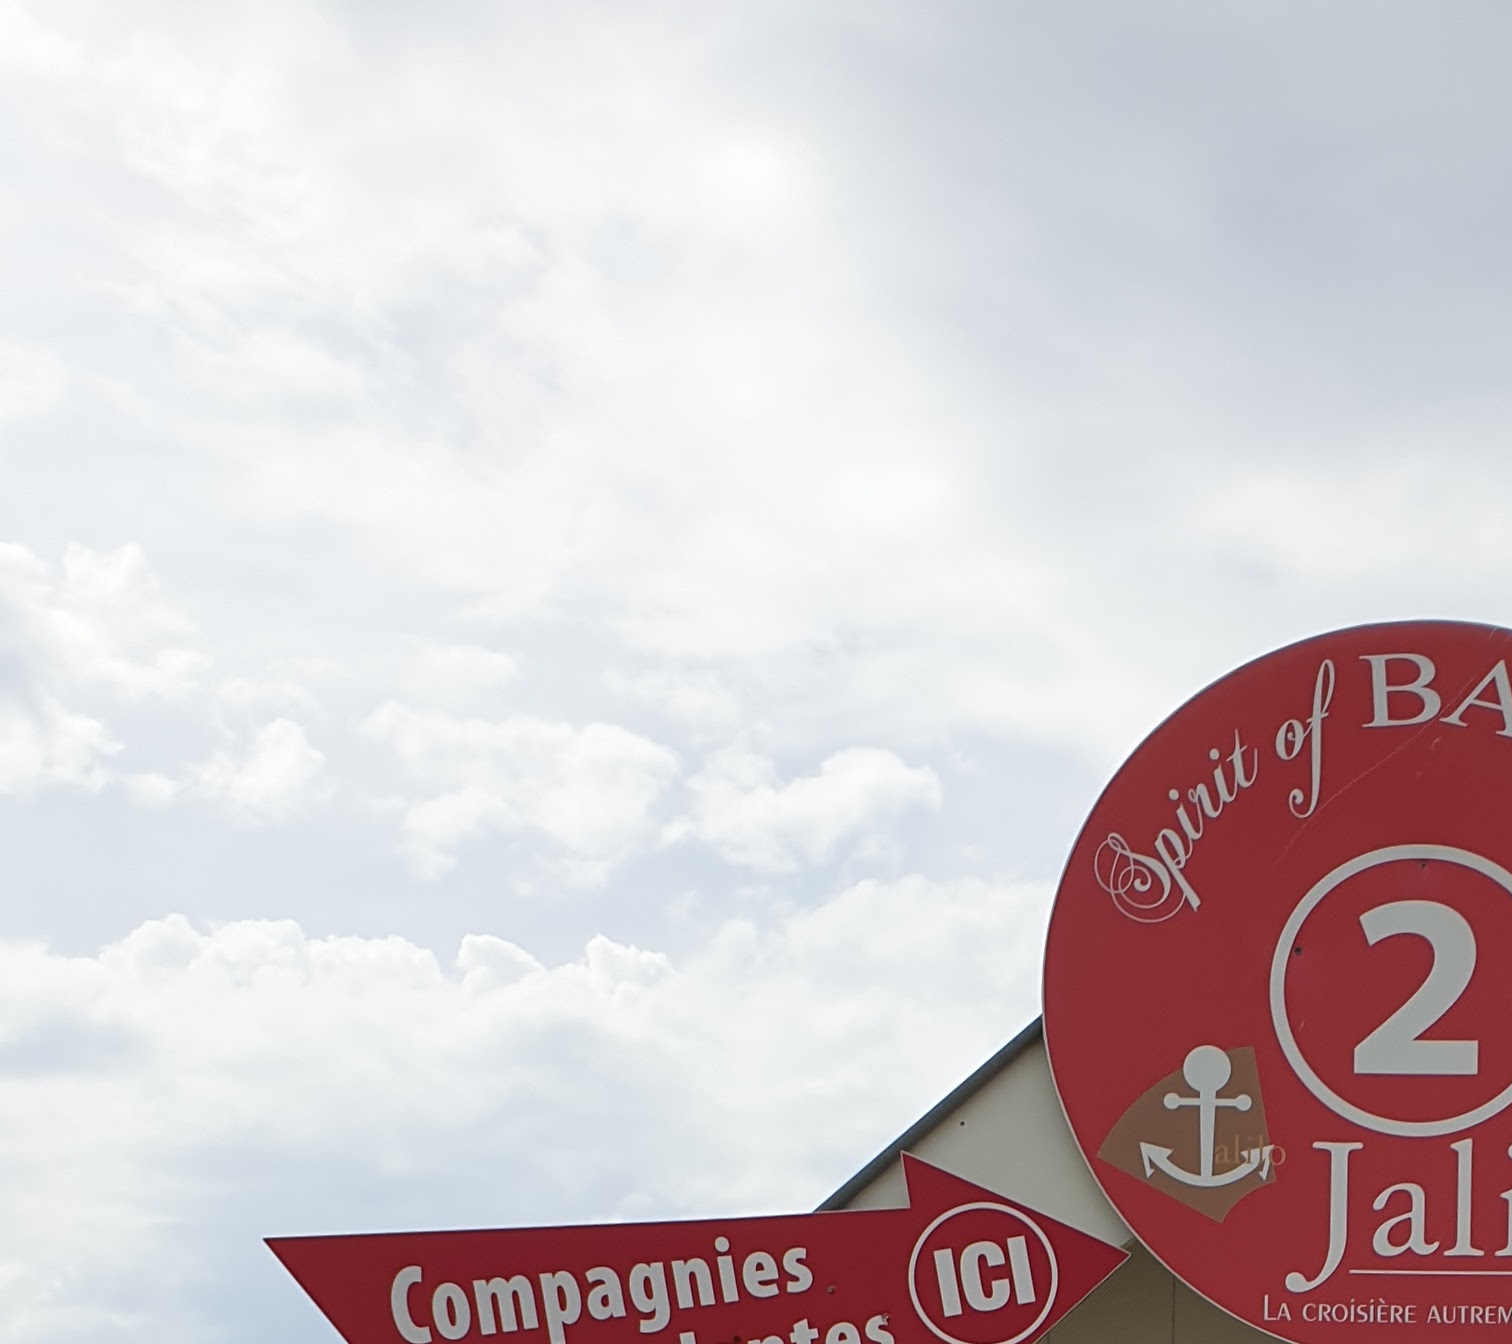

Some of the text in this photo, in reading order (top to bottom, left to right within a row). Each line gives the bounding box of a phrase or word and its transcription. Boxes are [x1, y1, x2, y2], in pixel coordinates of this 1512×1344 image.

[1094, 728, 1259, 923] Spirit
[1275, 658, 1335, 818] of
[1353, 899, 1479, 1075] 2
[933, 1235, 1037, 1318] ICI
